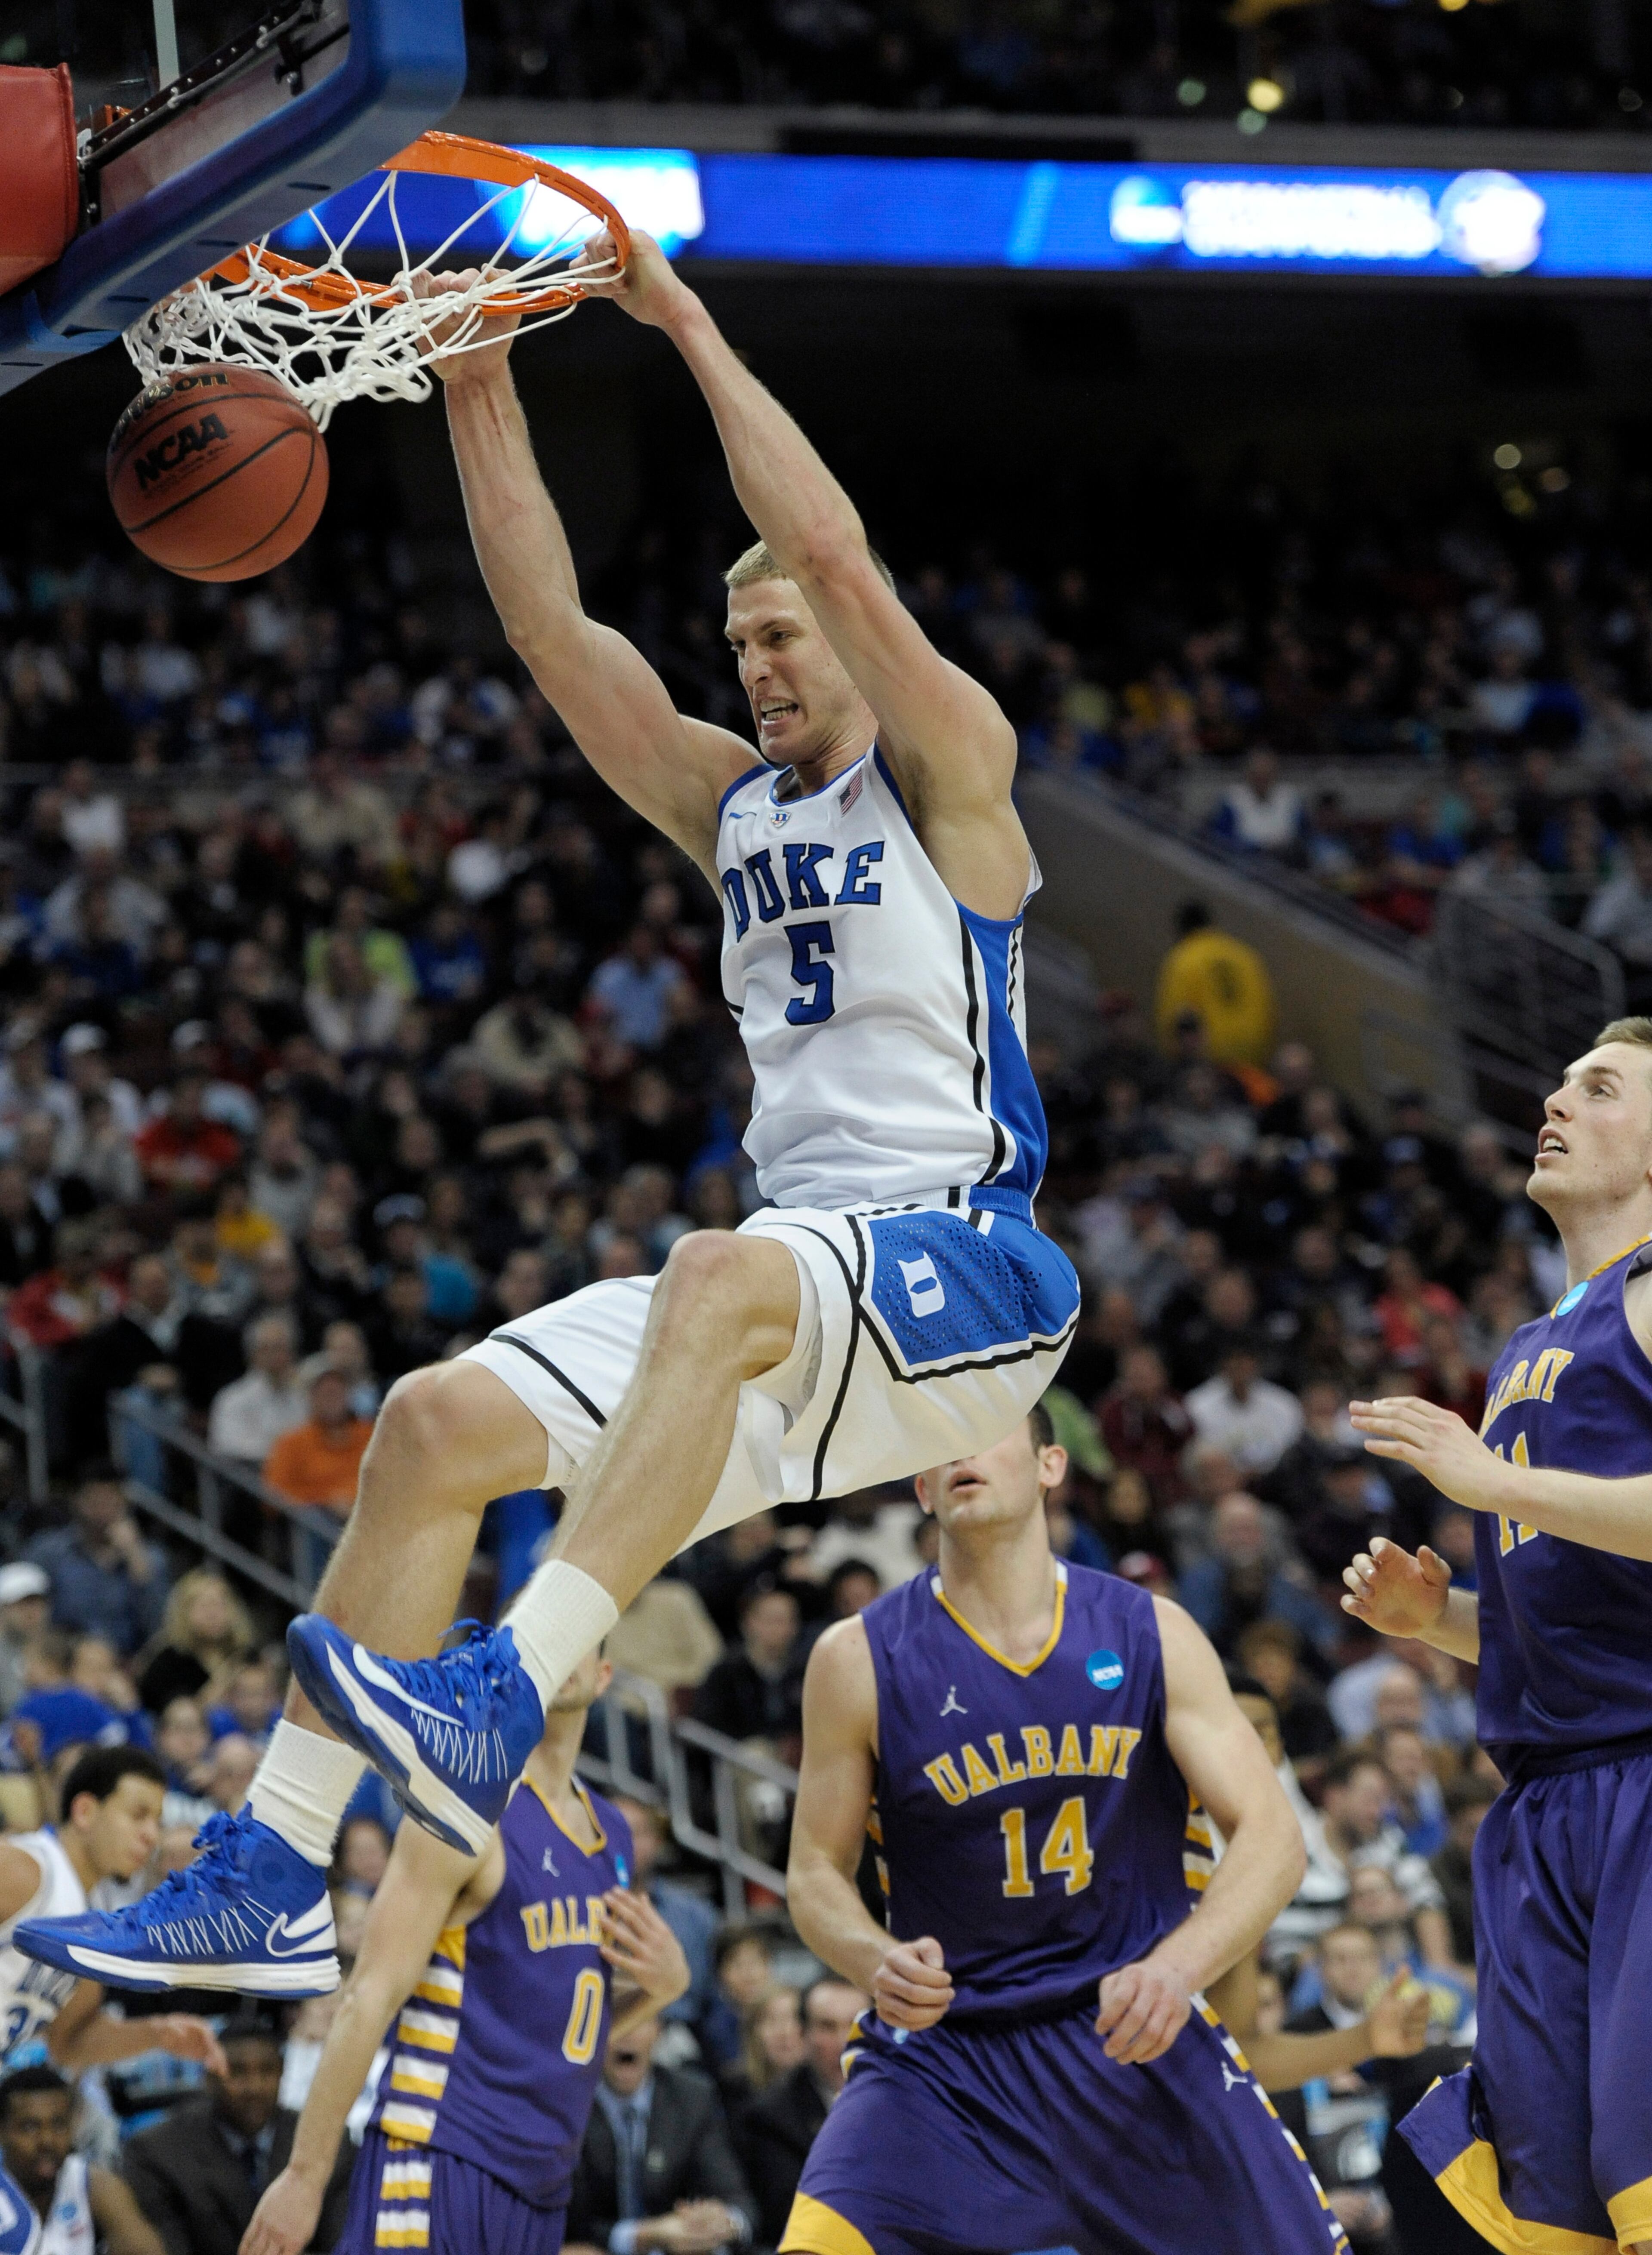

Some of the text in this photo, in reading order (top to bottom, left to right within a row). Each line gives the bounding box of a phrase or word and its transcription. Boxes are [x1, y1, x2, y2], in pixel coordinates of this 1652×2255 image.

[133, 413, 228, 490] NCAA
[721, 841, 885, 943] DUKE
[783, 920, 835, 1026] 5
[923, 1723, 1142, 1806] UALBANY
[1000, 1795, 1094, 1898] 14
[520, 1895, 613, 1953] UALB
[561, 1967, 604, 2065] 0
